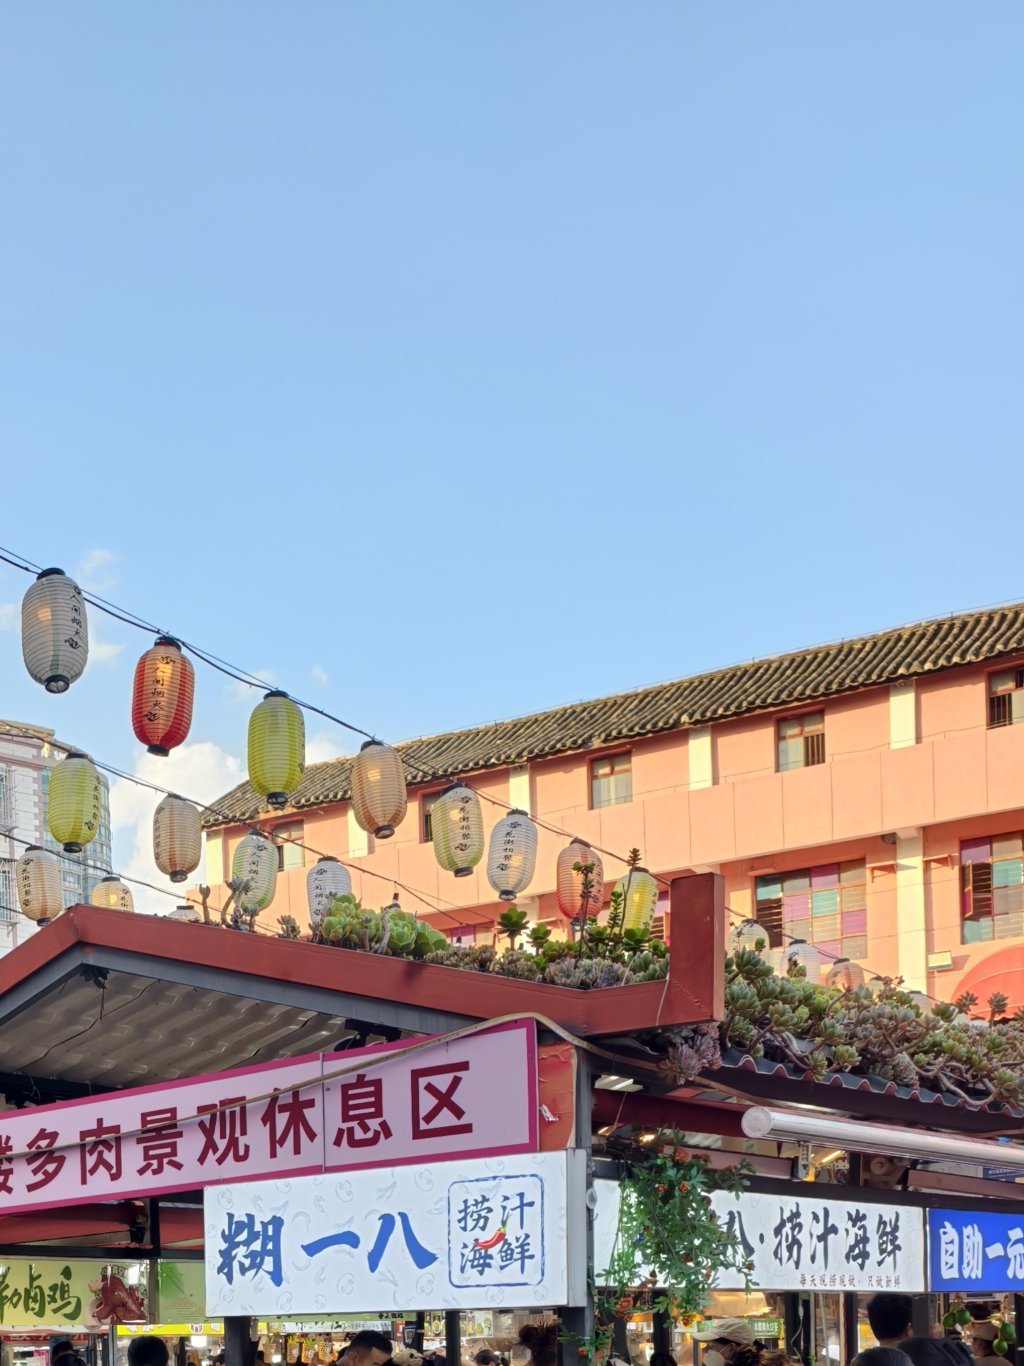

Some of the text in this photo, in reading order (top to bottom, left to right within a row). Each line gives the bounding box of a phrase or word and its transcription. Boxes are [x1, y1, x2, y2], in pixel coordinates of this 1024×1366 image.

[150, 666, 166, 711] 人间烟火
[457, 1191, 536, 1233] 捞汁
[216, 1211, 439, 1287] 糊一八
[458, 1235, 536, 1277] 海鲜
